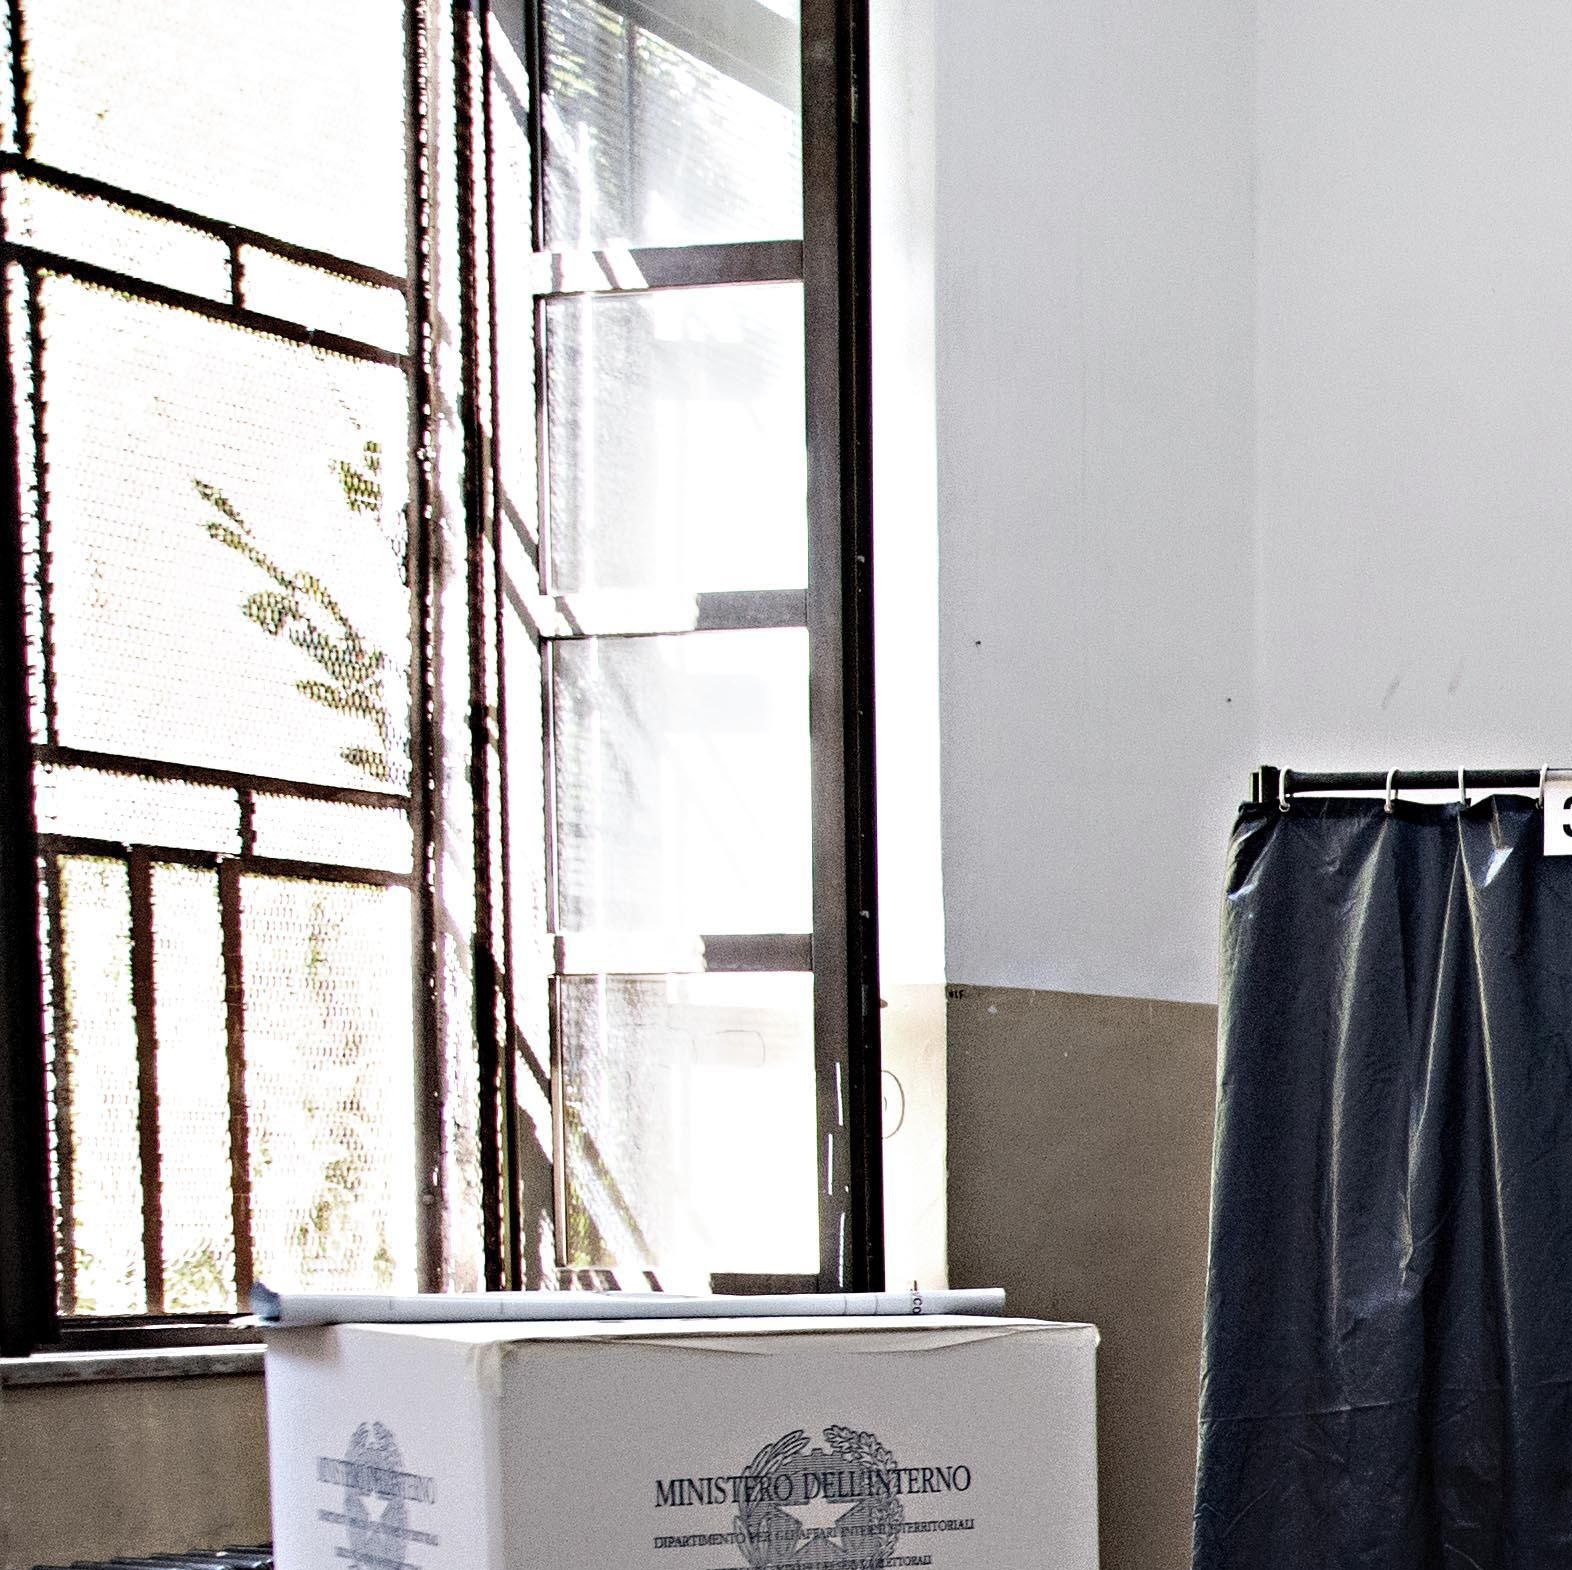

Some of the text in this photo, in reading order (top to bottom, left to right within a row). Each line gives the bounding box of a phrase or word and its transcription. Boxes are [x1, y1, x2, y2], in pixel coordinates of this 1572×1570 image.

[655, 1465, 972, 1508] MINISTERO DELL'INTERNO
[653, 1532, 746, 1549] DIPARTIMENTO
[900, 1518, 975, 1535] TERRITORIALI
